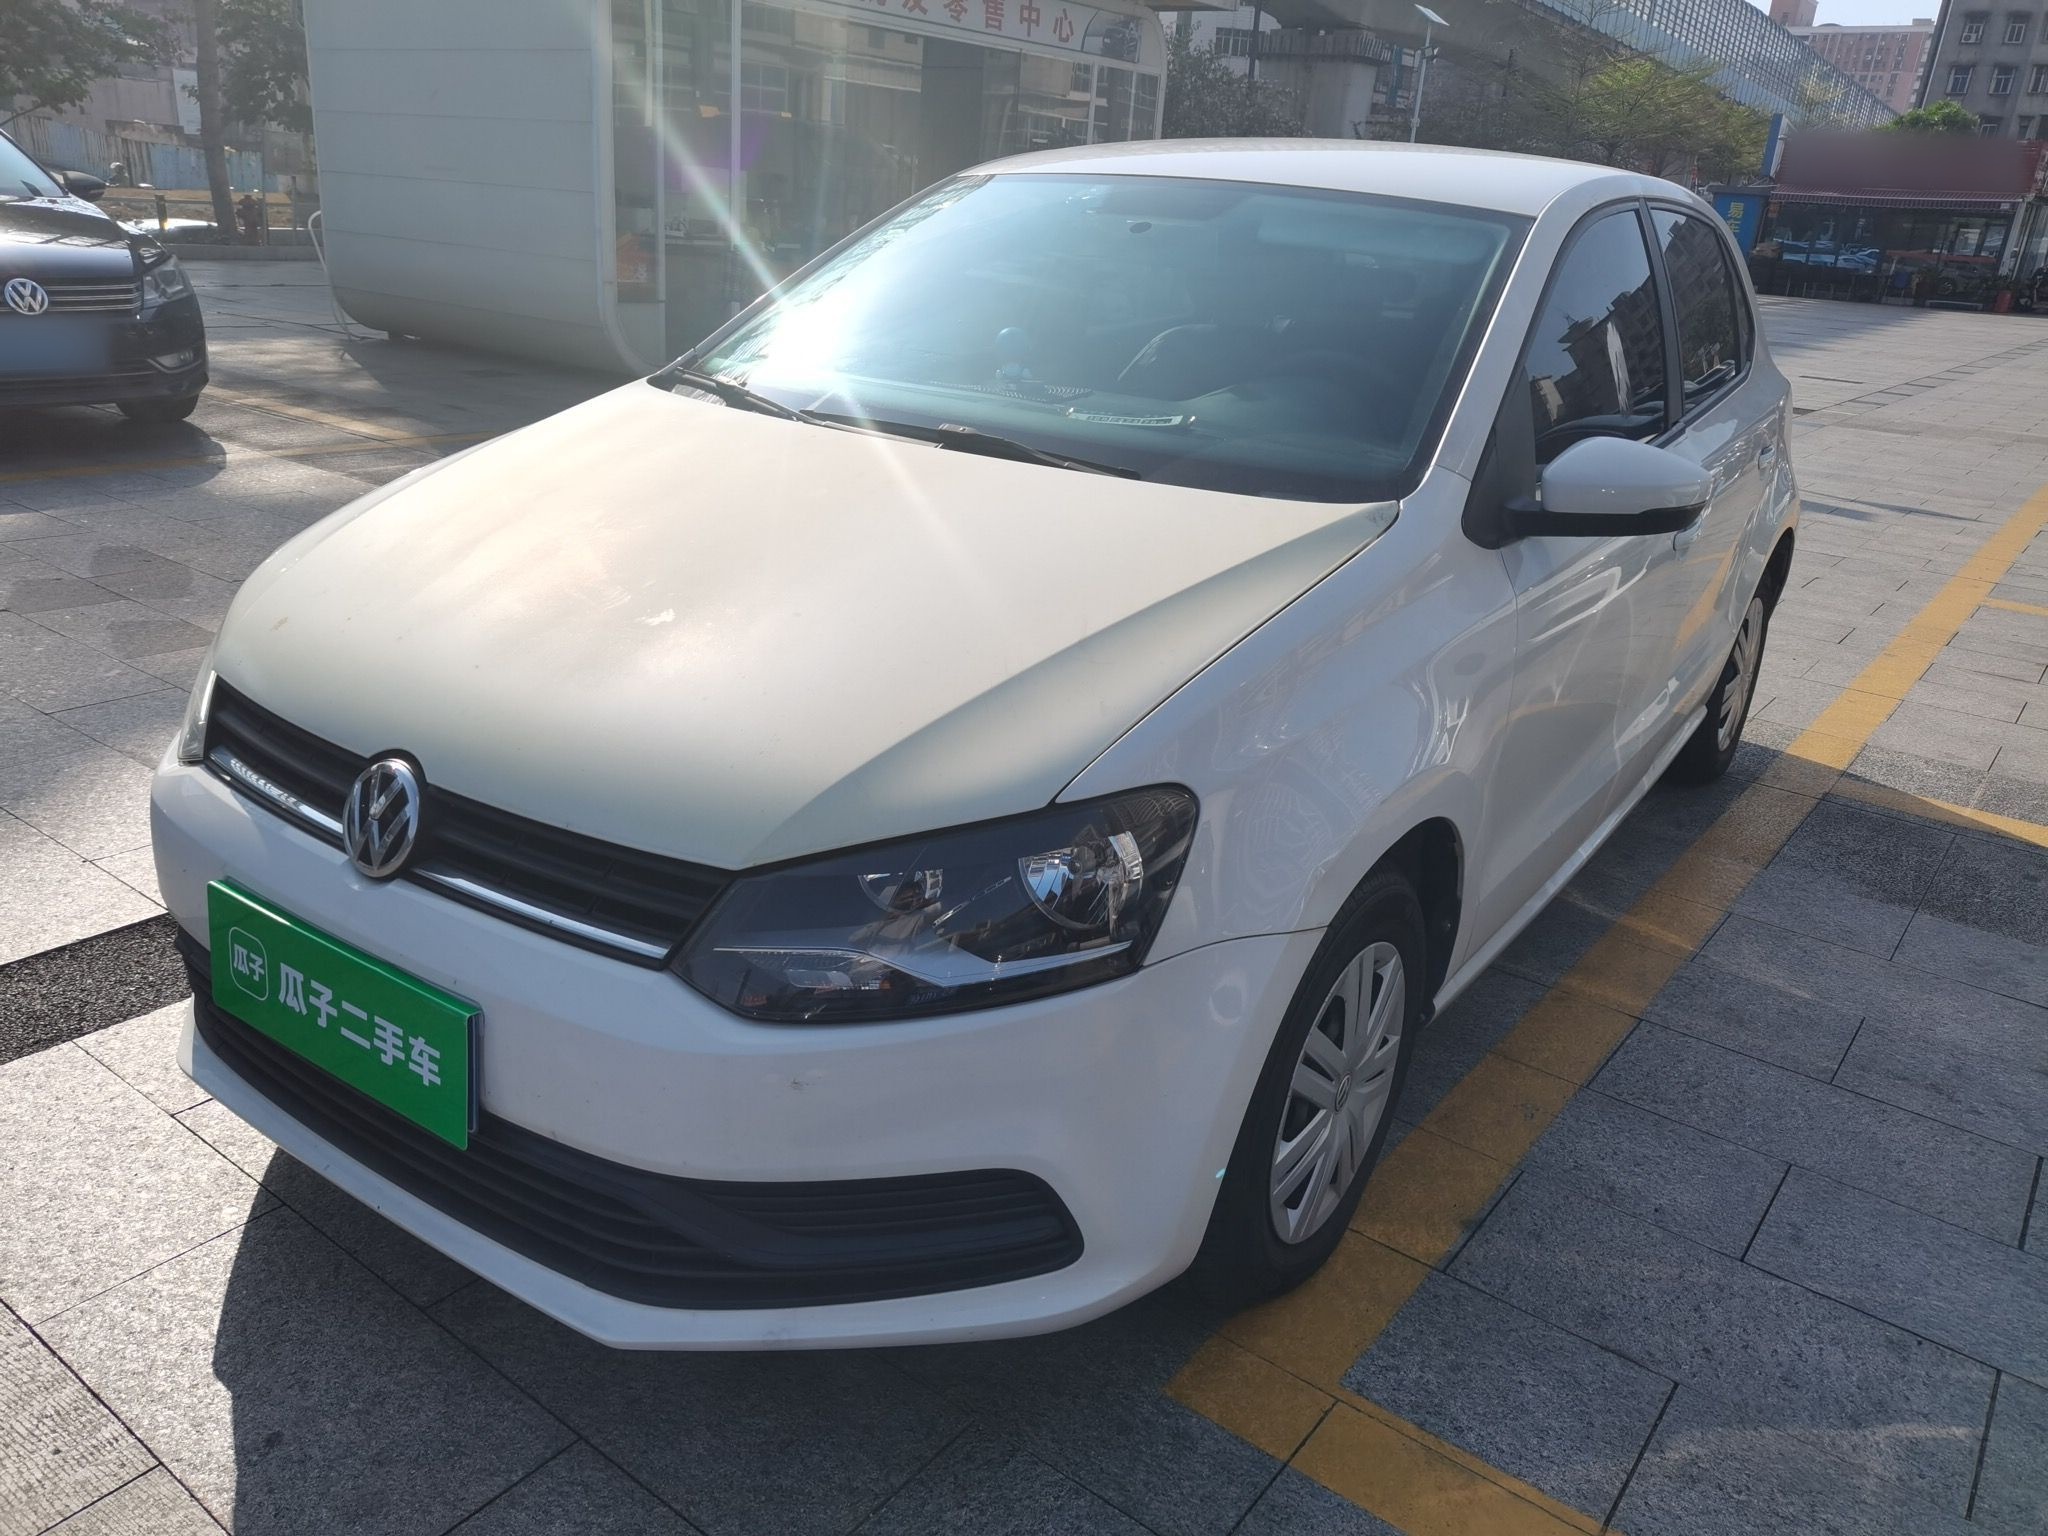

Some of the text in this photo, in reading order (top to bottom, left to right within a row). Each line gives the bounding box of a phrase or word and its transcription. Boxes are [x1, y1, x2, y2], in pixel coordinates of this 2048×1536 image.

[859, 0, 1074, 43] 零售中心
[233, 943, 265, 982] 瓜子
[278, 962, 441, 1087] 瓜子二手车
